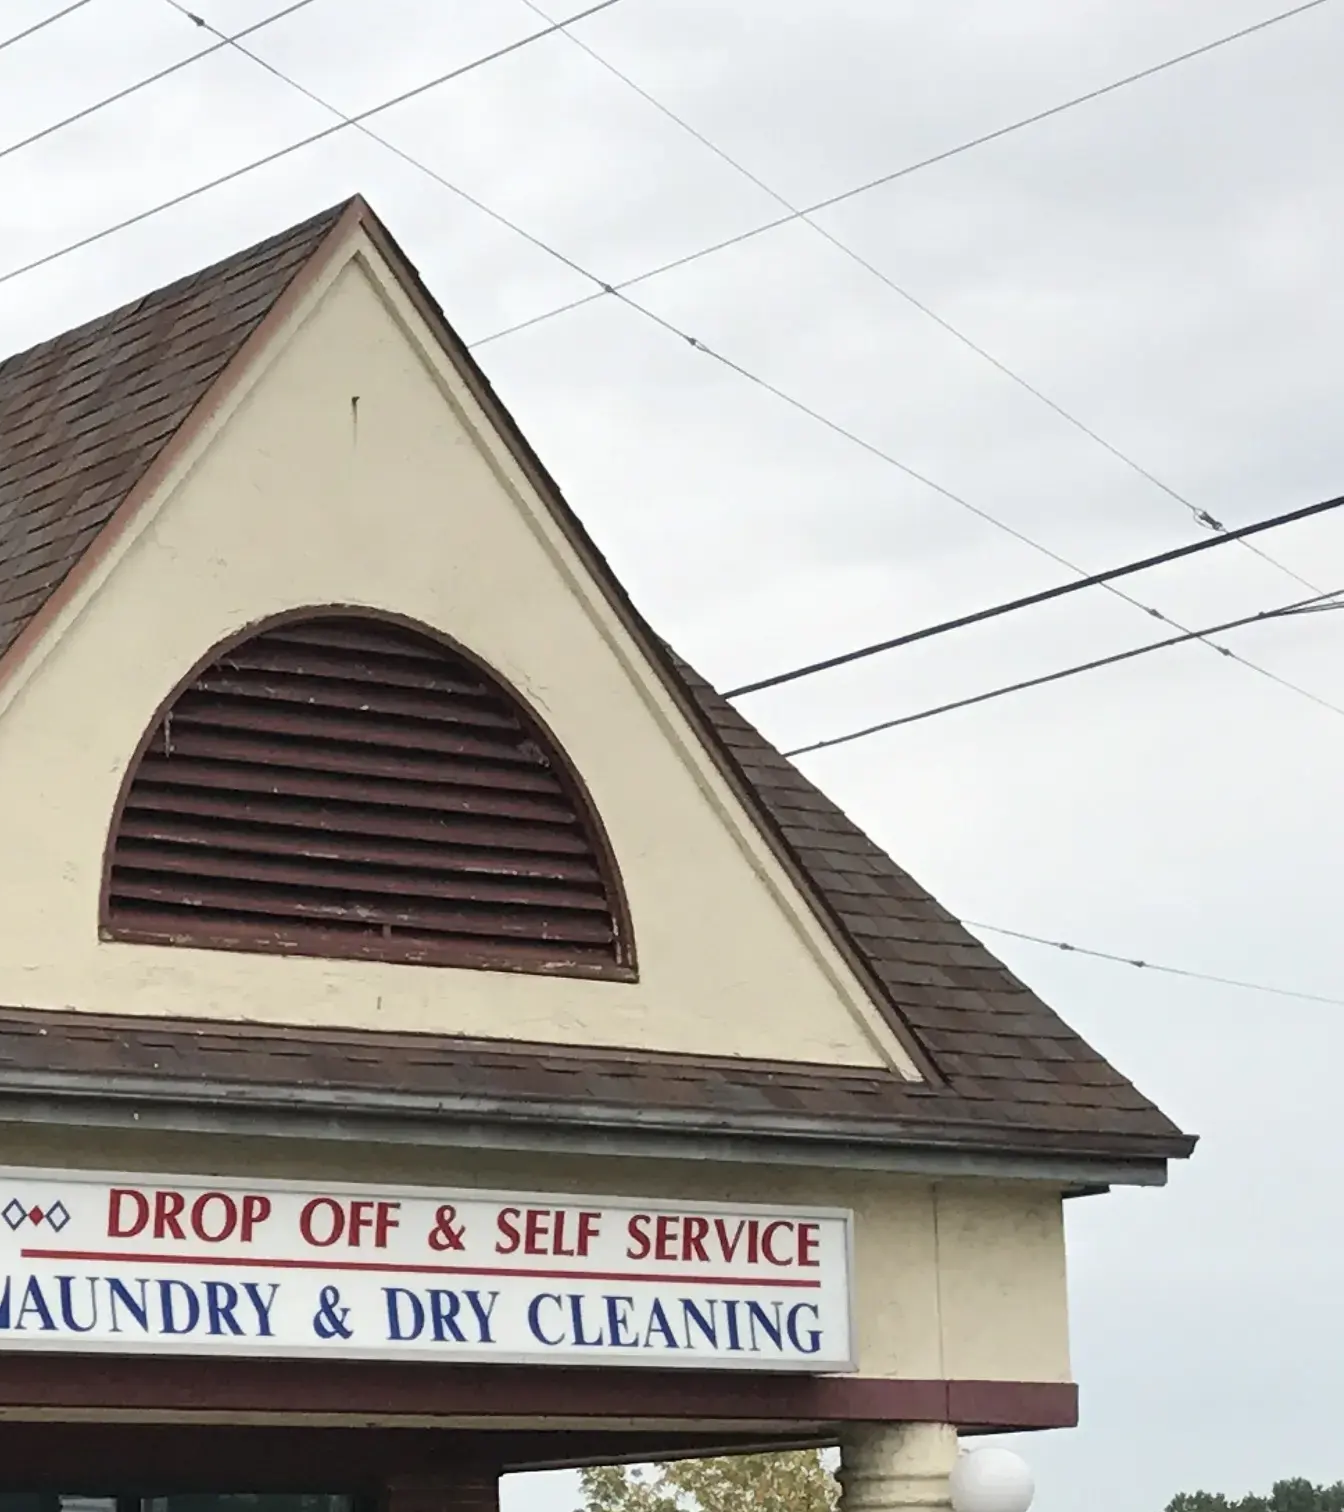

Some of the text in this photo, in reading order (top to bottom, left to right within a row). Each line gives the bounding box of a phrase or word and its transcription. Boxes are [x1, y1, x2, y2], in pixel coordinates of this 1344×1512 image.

[107, 1188, 820, 1268] DROP OFF & SELF SERVICE
[313, 1285, 354, 1340] &
[381, 1287, 500, 1344] DRY
[528, 1293, 824, 1354] CLEANING
